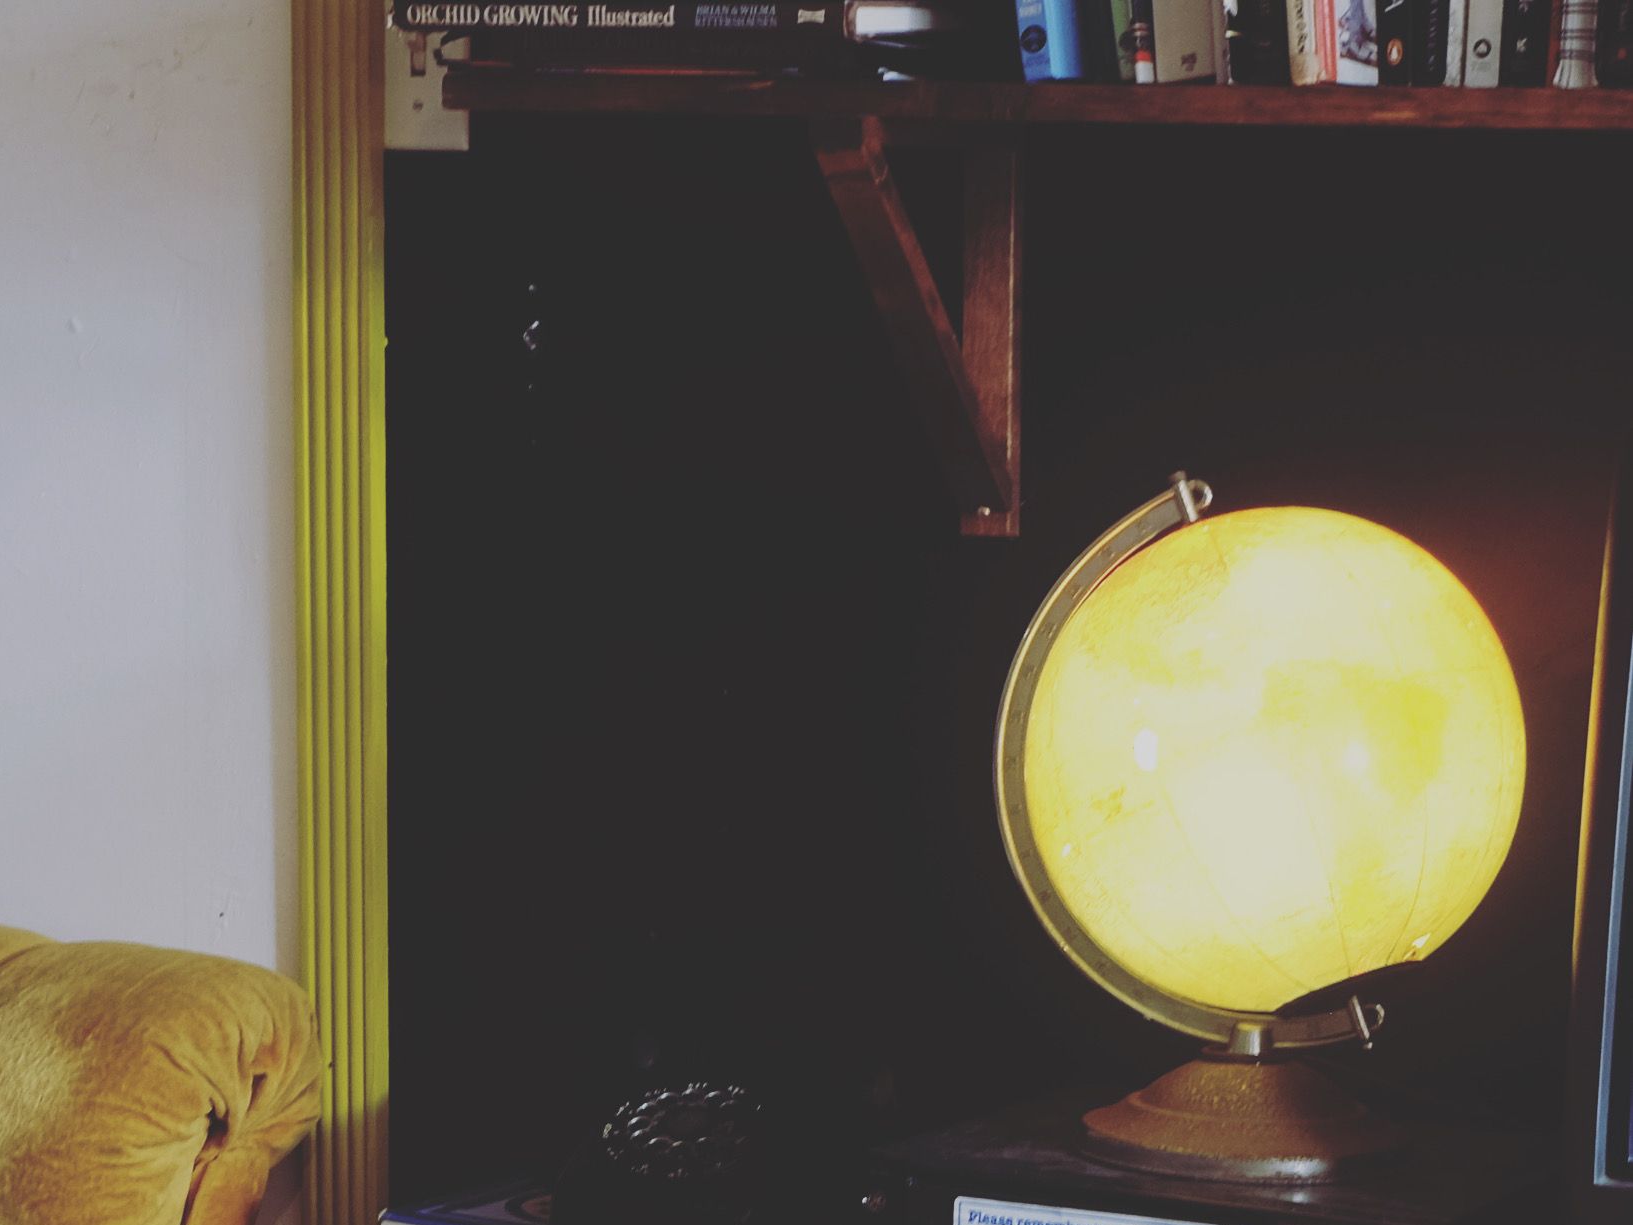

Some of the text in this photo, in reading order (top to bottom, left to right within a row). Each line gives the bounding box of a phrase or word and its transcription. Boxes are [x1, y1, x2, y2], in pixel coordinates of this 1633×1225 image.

[406, 3, 675, 28] ORCHID GROWING Illustrated
